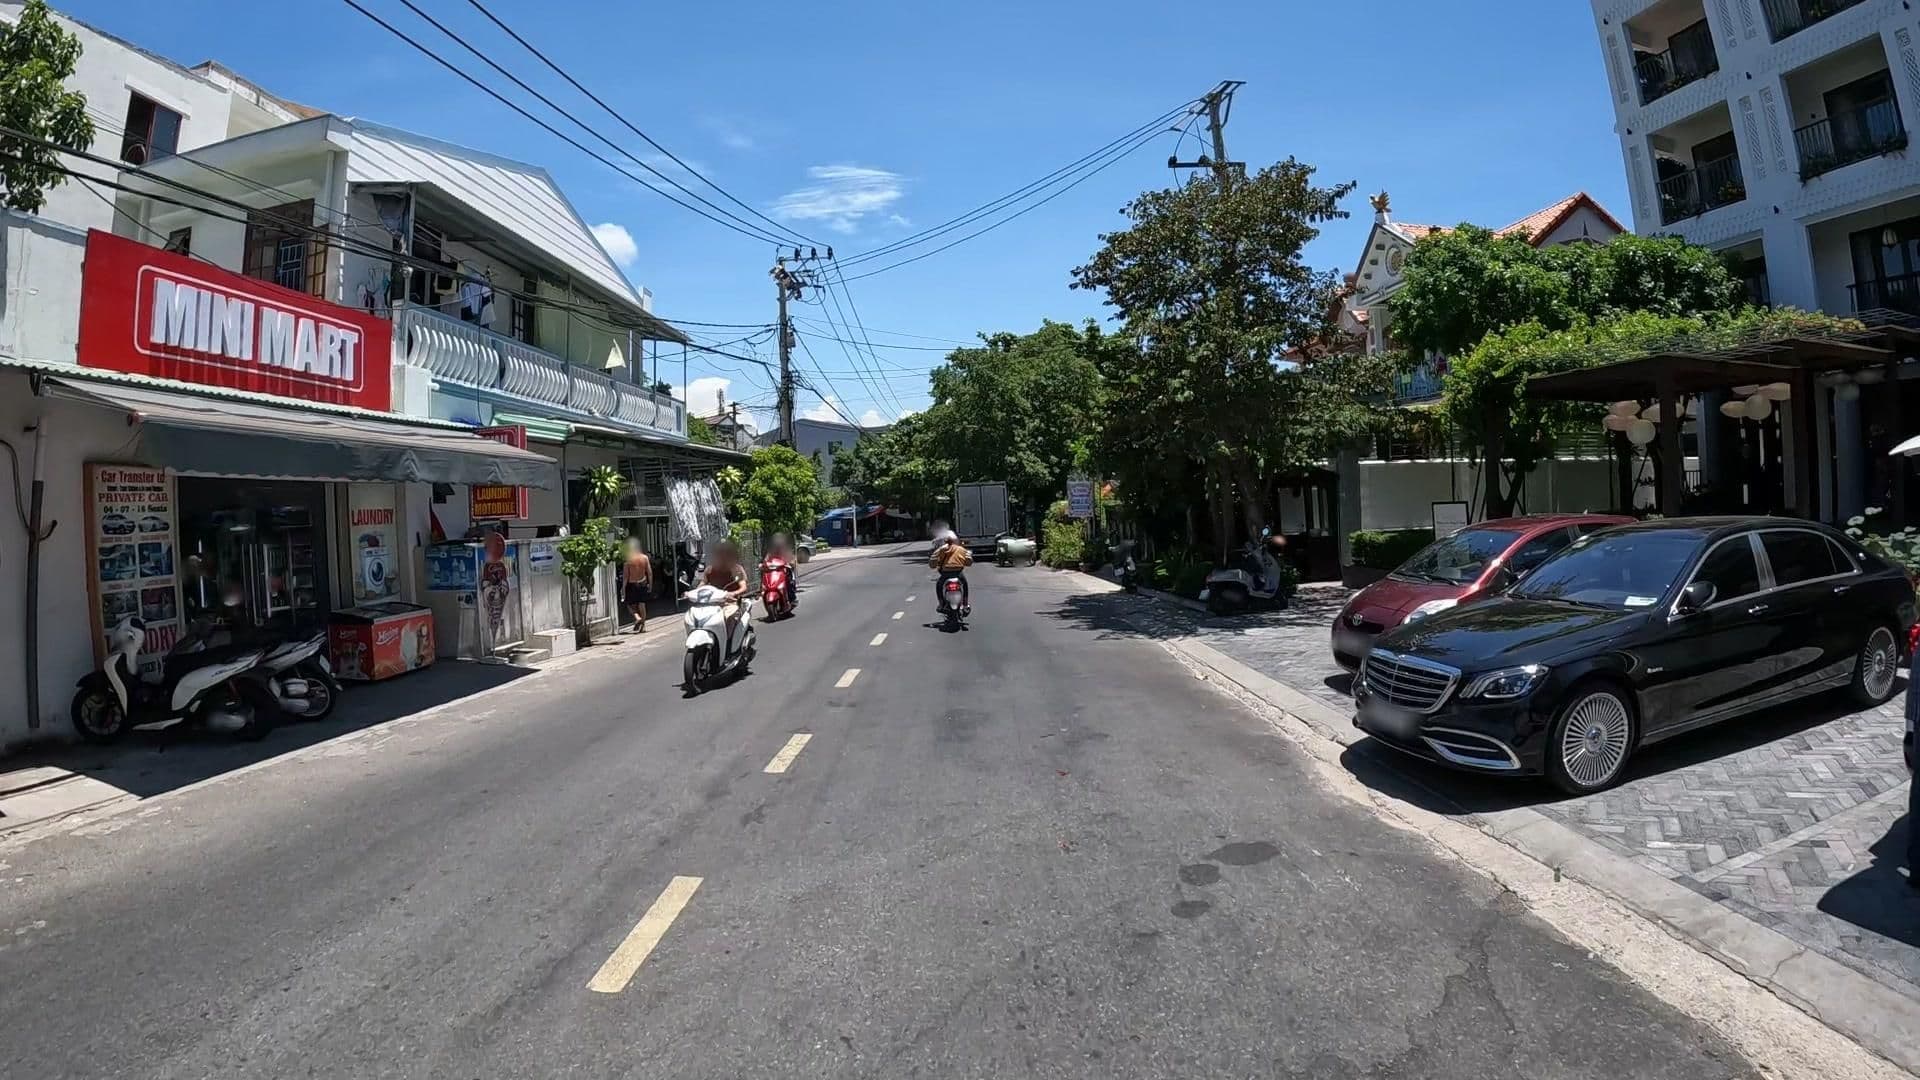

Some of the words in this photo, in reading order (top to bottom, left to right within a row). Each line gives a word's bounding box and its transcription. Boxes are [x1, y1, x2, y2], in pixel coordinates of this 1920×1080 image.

[151, 277, 255, 360] MINI
[258, 306, 359, 381] MART
[101, 470, 116, 483] Car
[119, 471, 155, 483] Transfer
[98, 493, 145, 502] PRIVATE
[148, 493, 168, 502] CAR
[477, 487, 512, 500] LAUNDRY
[351, 509, 393, 526] LAUNDRY
